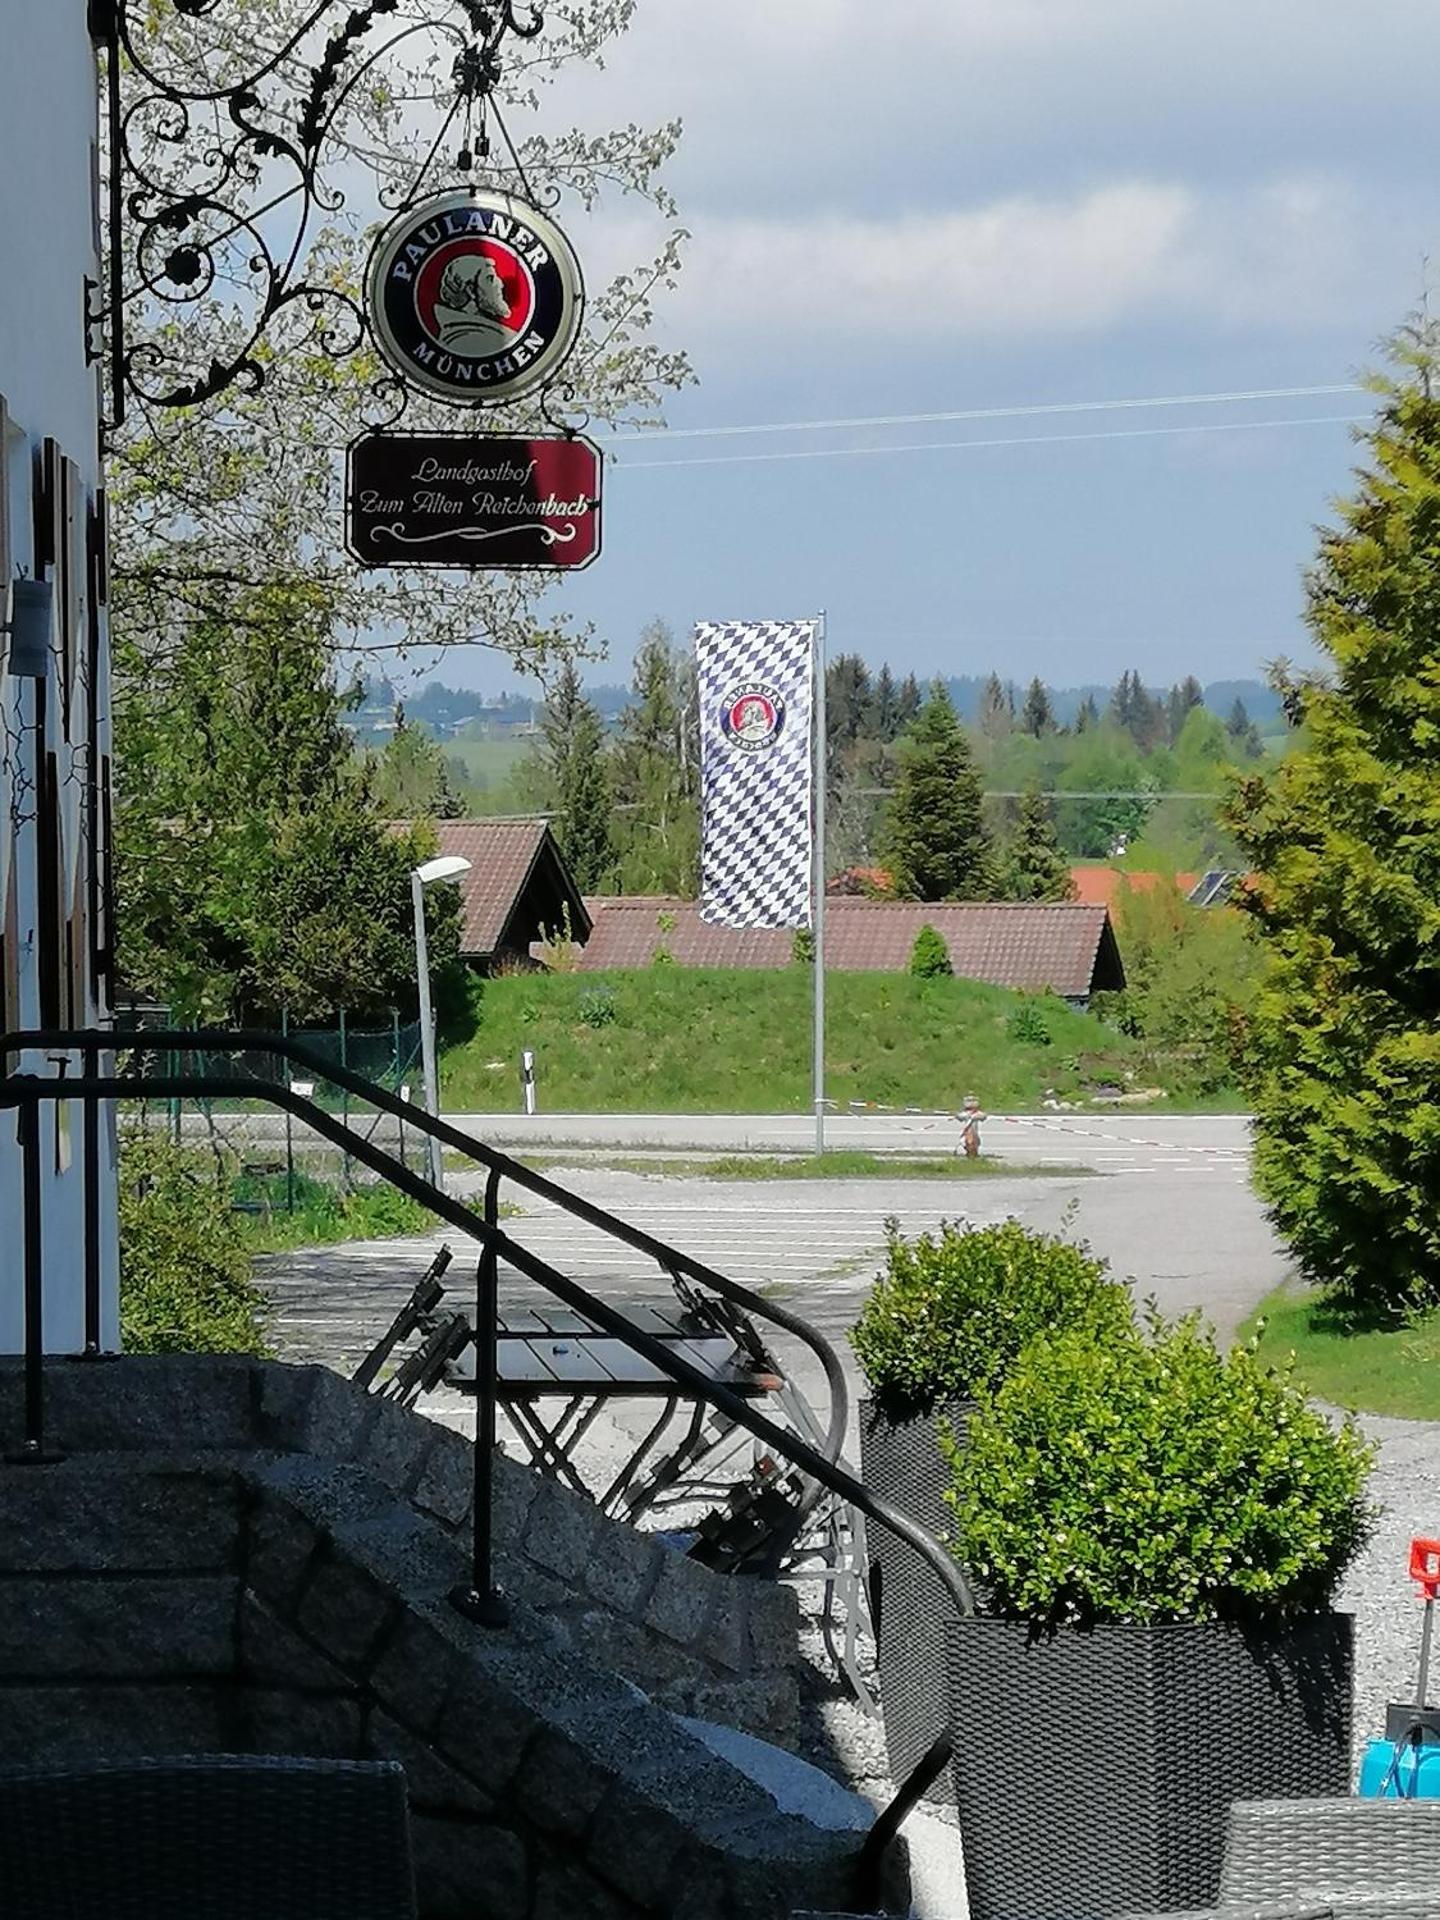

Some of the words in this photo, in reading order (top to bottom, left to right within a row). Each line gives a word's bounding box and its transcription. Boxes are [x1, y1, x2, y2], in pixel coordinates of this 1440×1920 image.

[393, 212, 549, 282] PAULANER
[413, 331, 545, 381] MÜNCHEN
[411, 458, 538, 487] Landgasthof
[360, 490, 404, 513] Zum
[412, 491, 463, 514] Alten
[472, 493, 588, 517] Reichenbach
